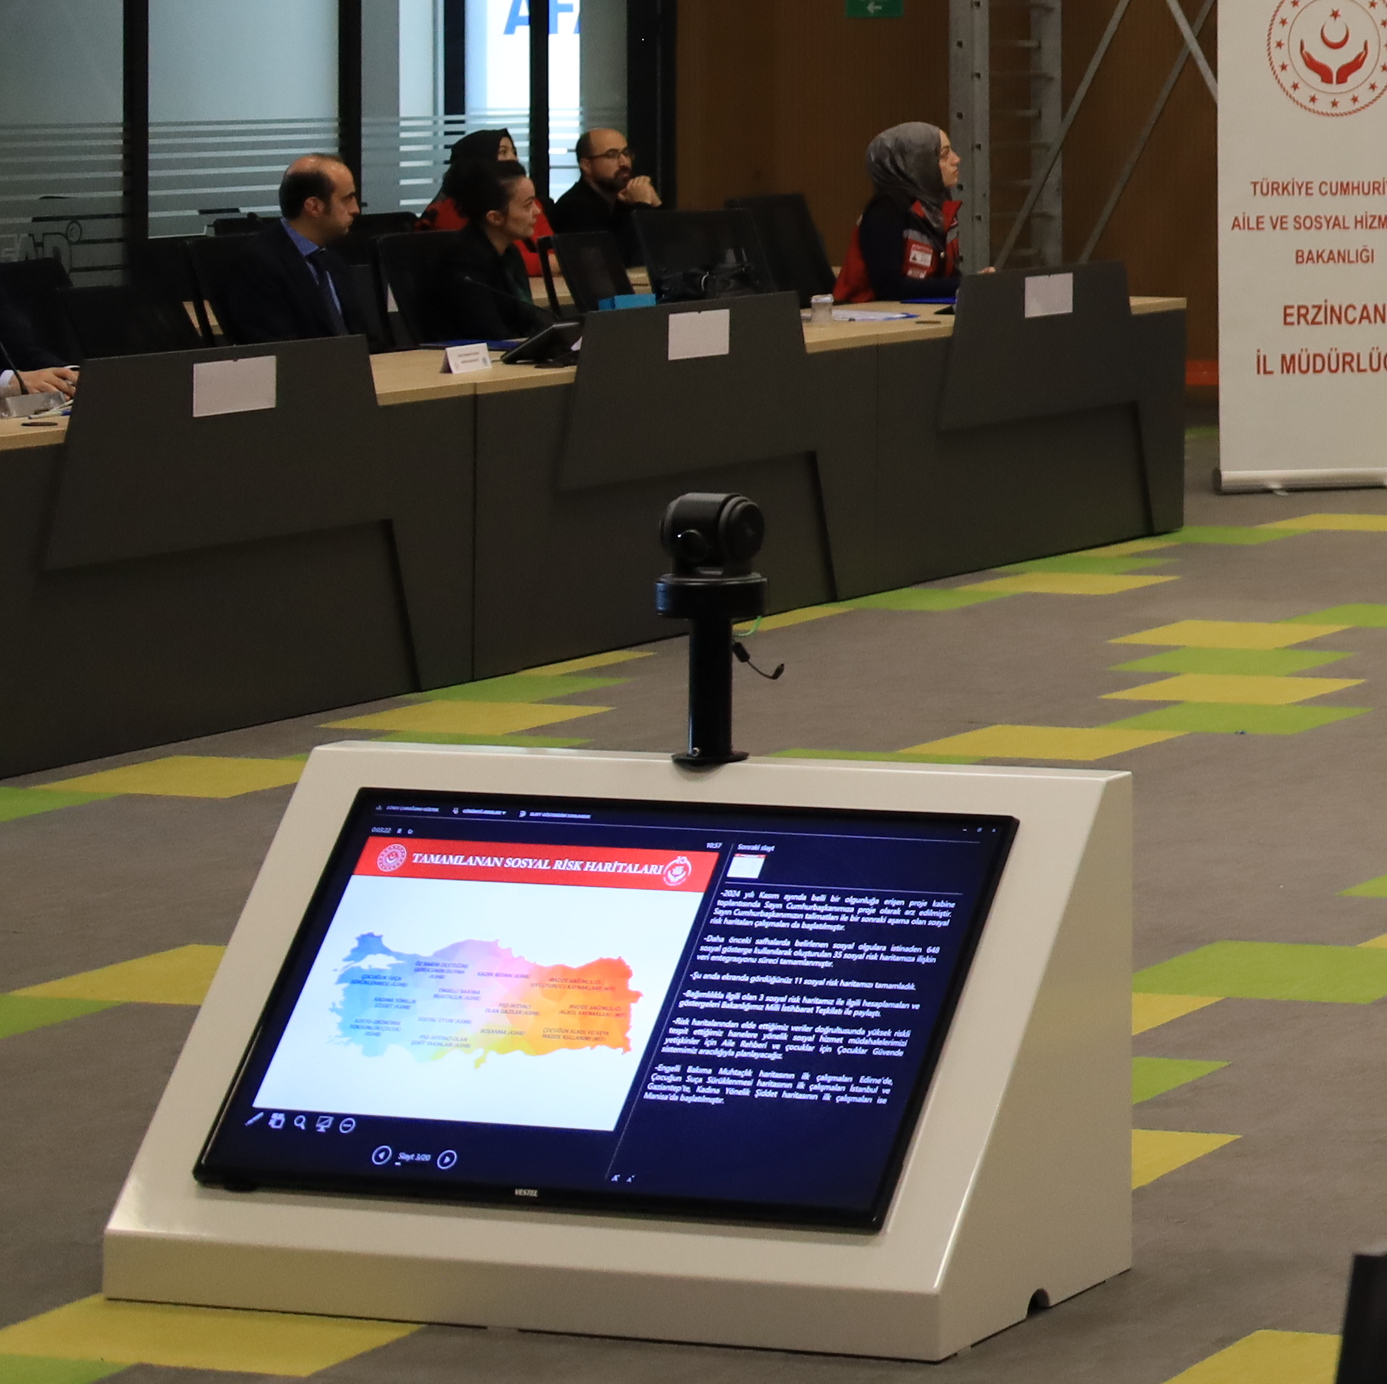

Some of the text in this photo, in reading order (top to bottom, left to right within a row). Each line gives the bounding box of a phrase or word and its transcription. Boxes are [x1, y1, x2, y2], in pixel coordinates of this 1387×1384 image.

[1251, 177, 1314, 197] TÜRKİYE
[1231, 212, 1266, 231] AİLE
[1270, 215, 1288, 230] VE
[1293, 213, 1350, 230] SOSYAL
[1295, 245, 1374, 264] BAKANLIĞI
[1282, 299, 1387, 326] ERZİNCAN
[1256, 349, 1273, 375] İL
[412, 853, 665, 876] TAMAMLANAN SOSYAL RİSK HARİTALARI
[514, 1188, 538, 1198] VESTEL
